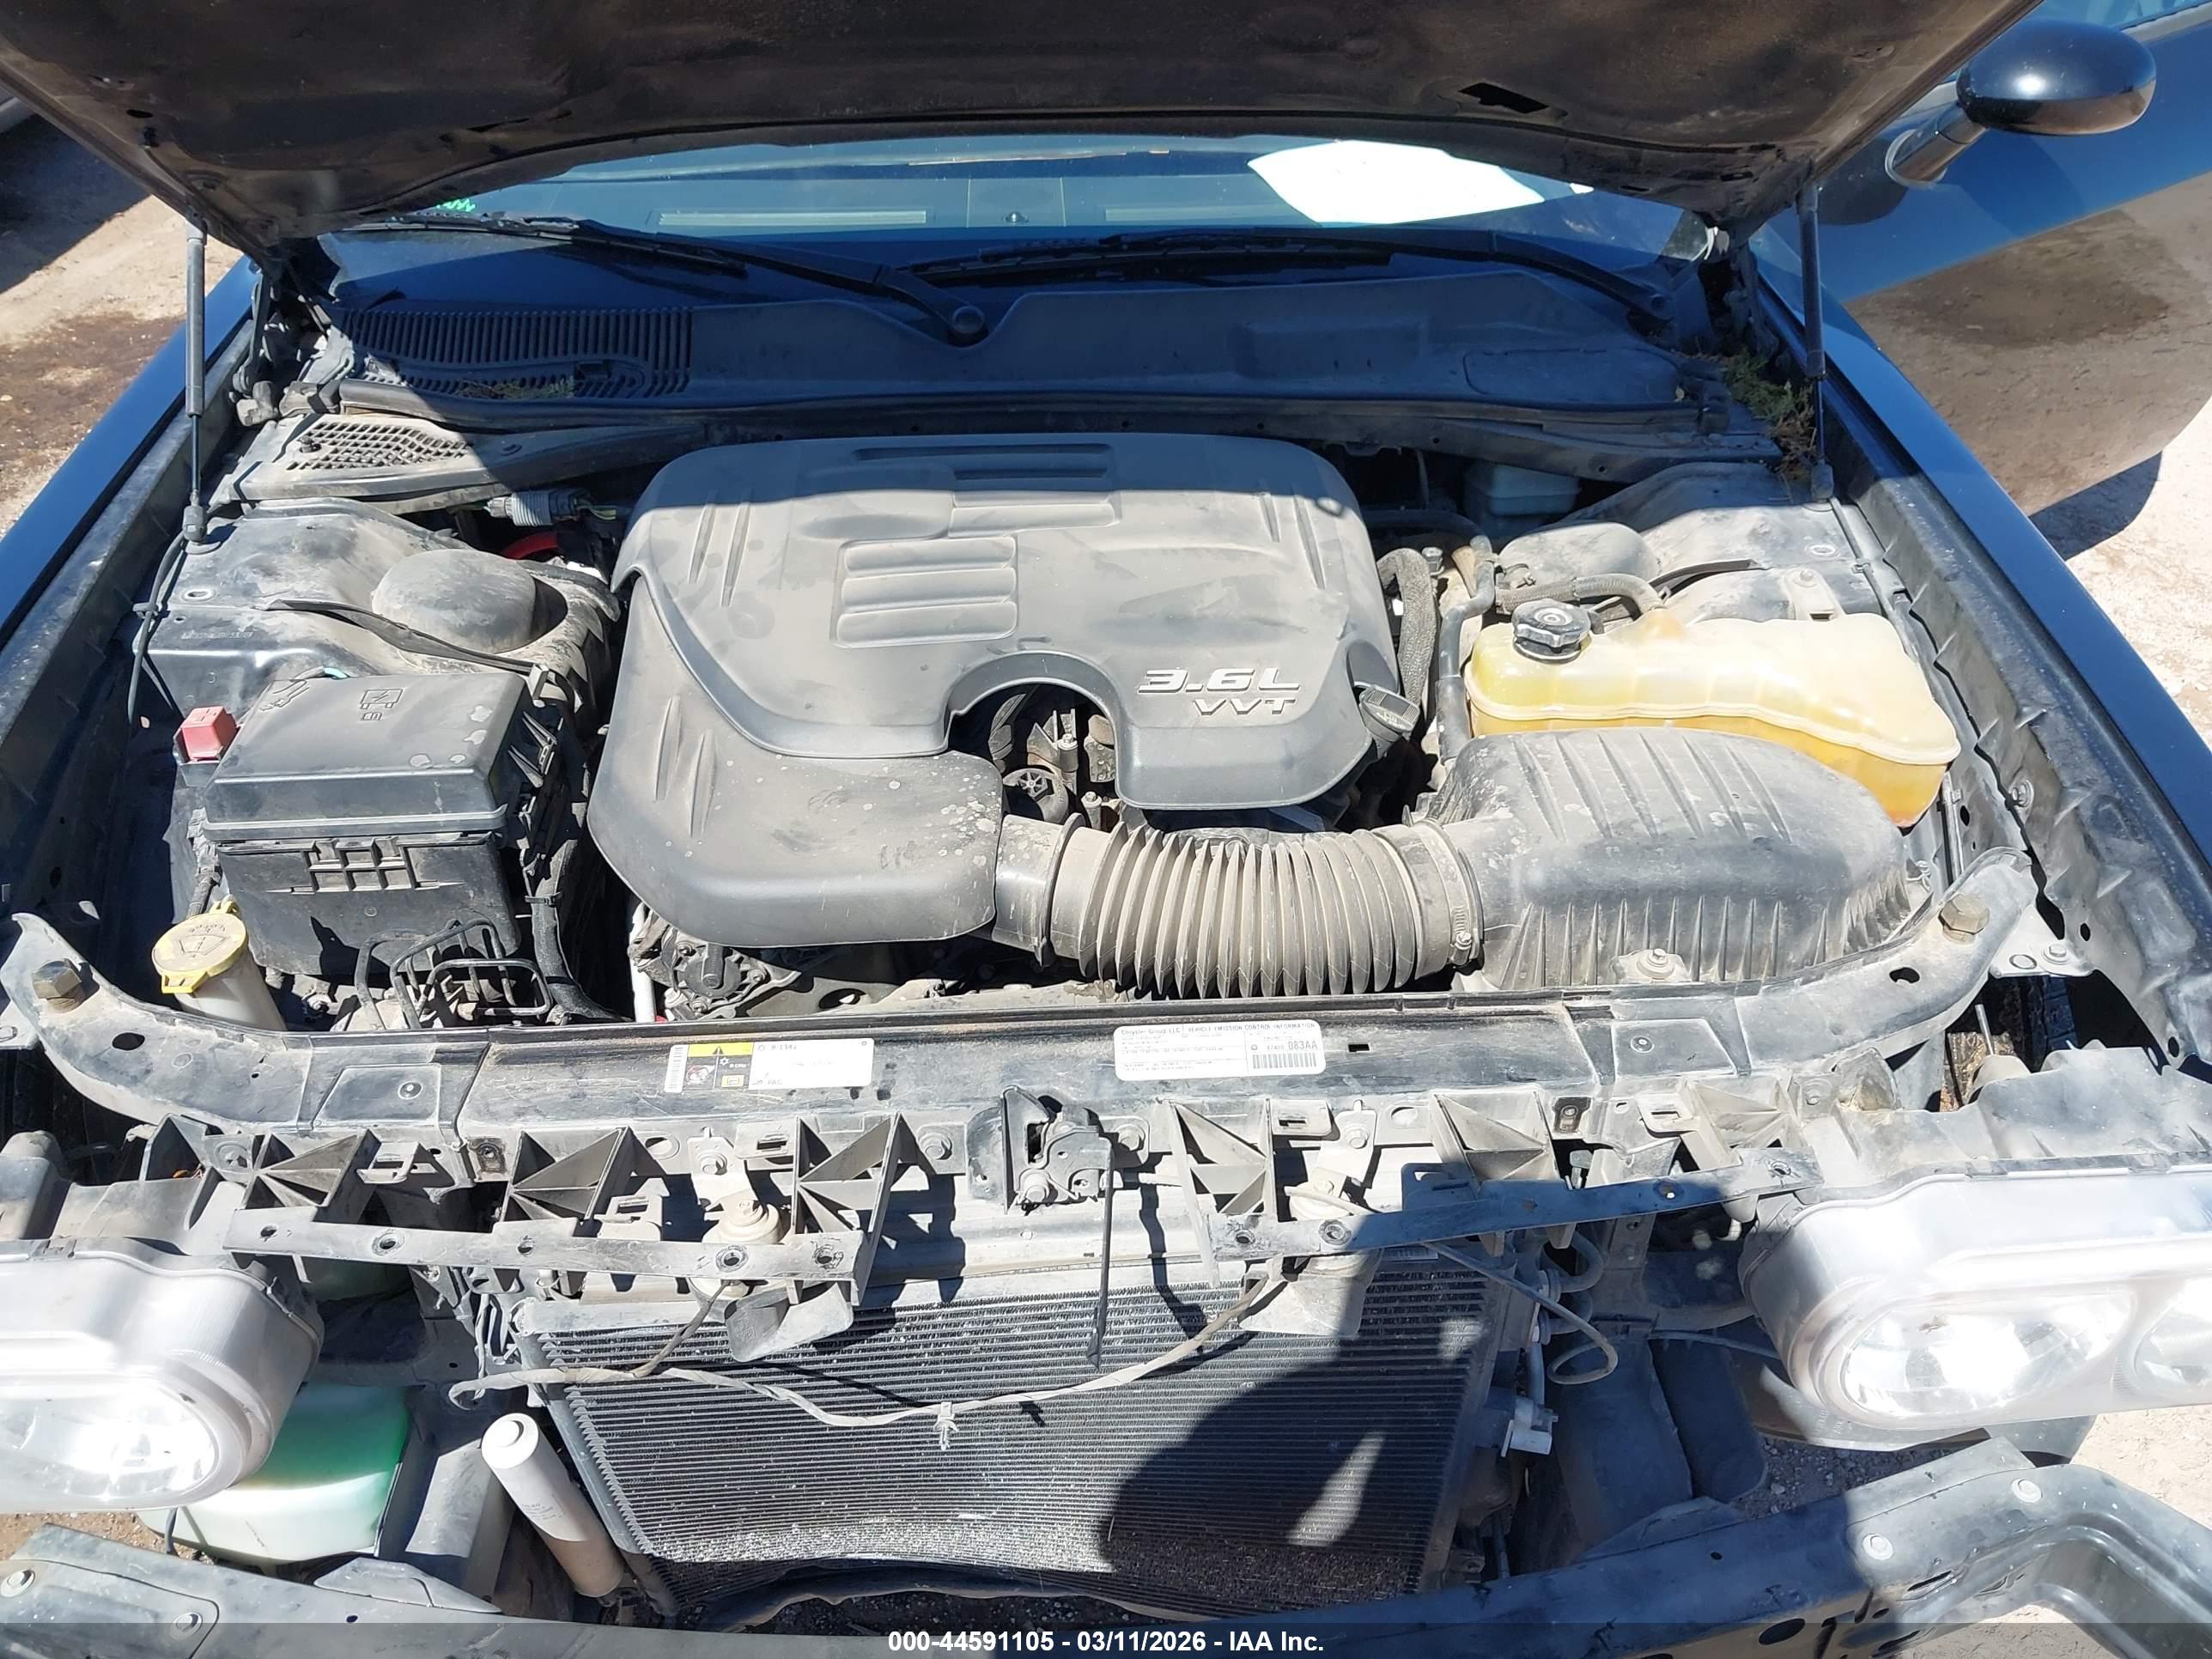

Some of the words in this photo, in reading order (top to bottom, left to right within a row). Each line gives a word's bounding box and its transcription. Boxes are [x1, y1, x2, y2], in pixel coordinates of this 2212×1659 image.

[1138, 667, 1302, 694] 3.6L
[1194, 697, 1297, 716] VVT
[1288, 1040, 1318, 1050] 083AA
